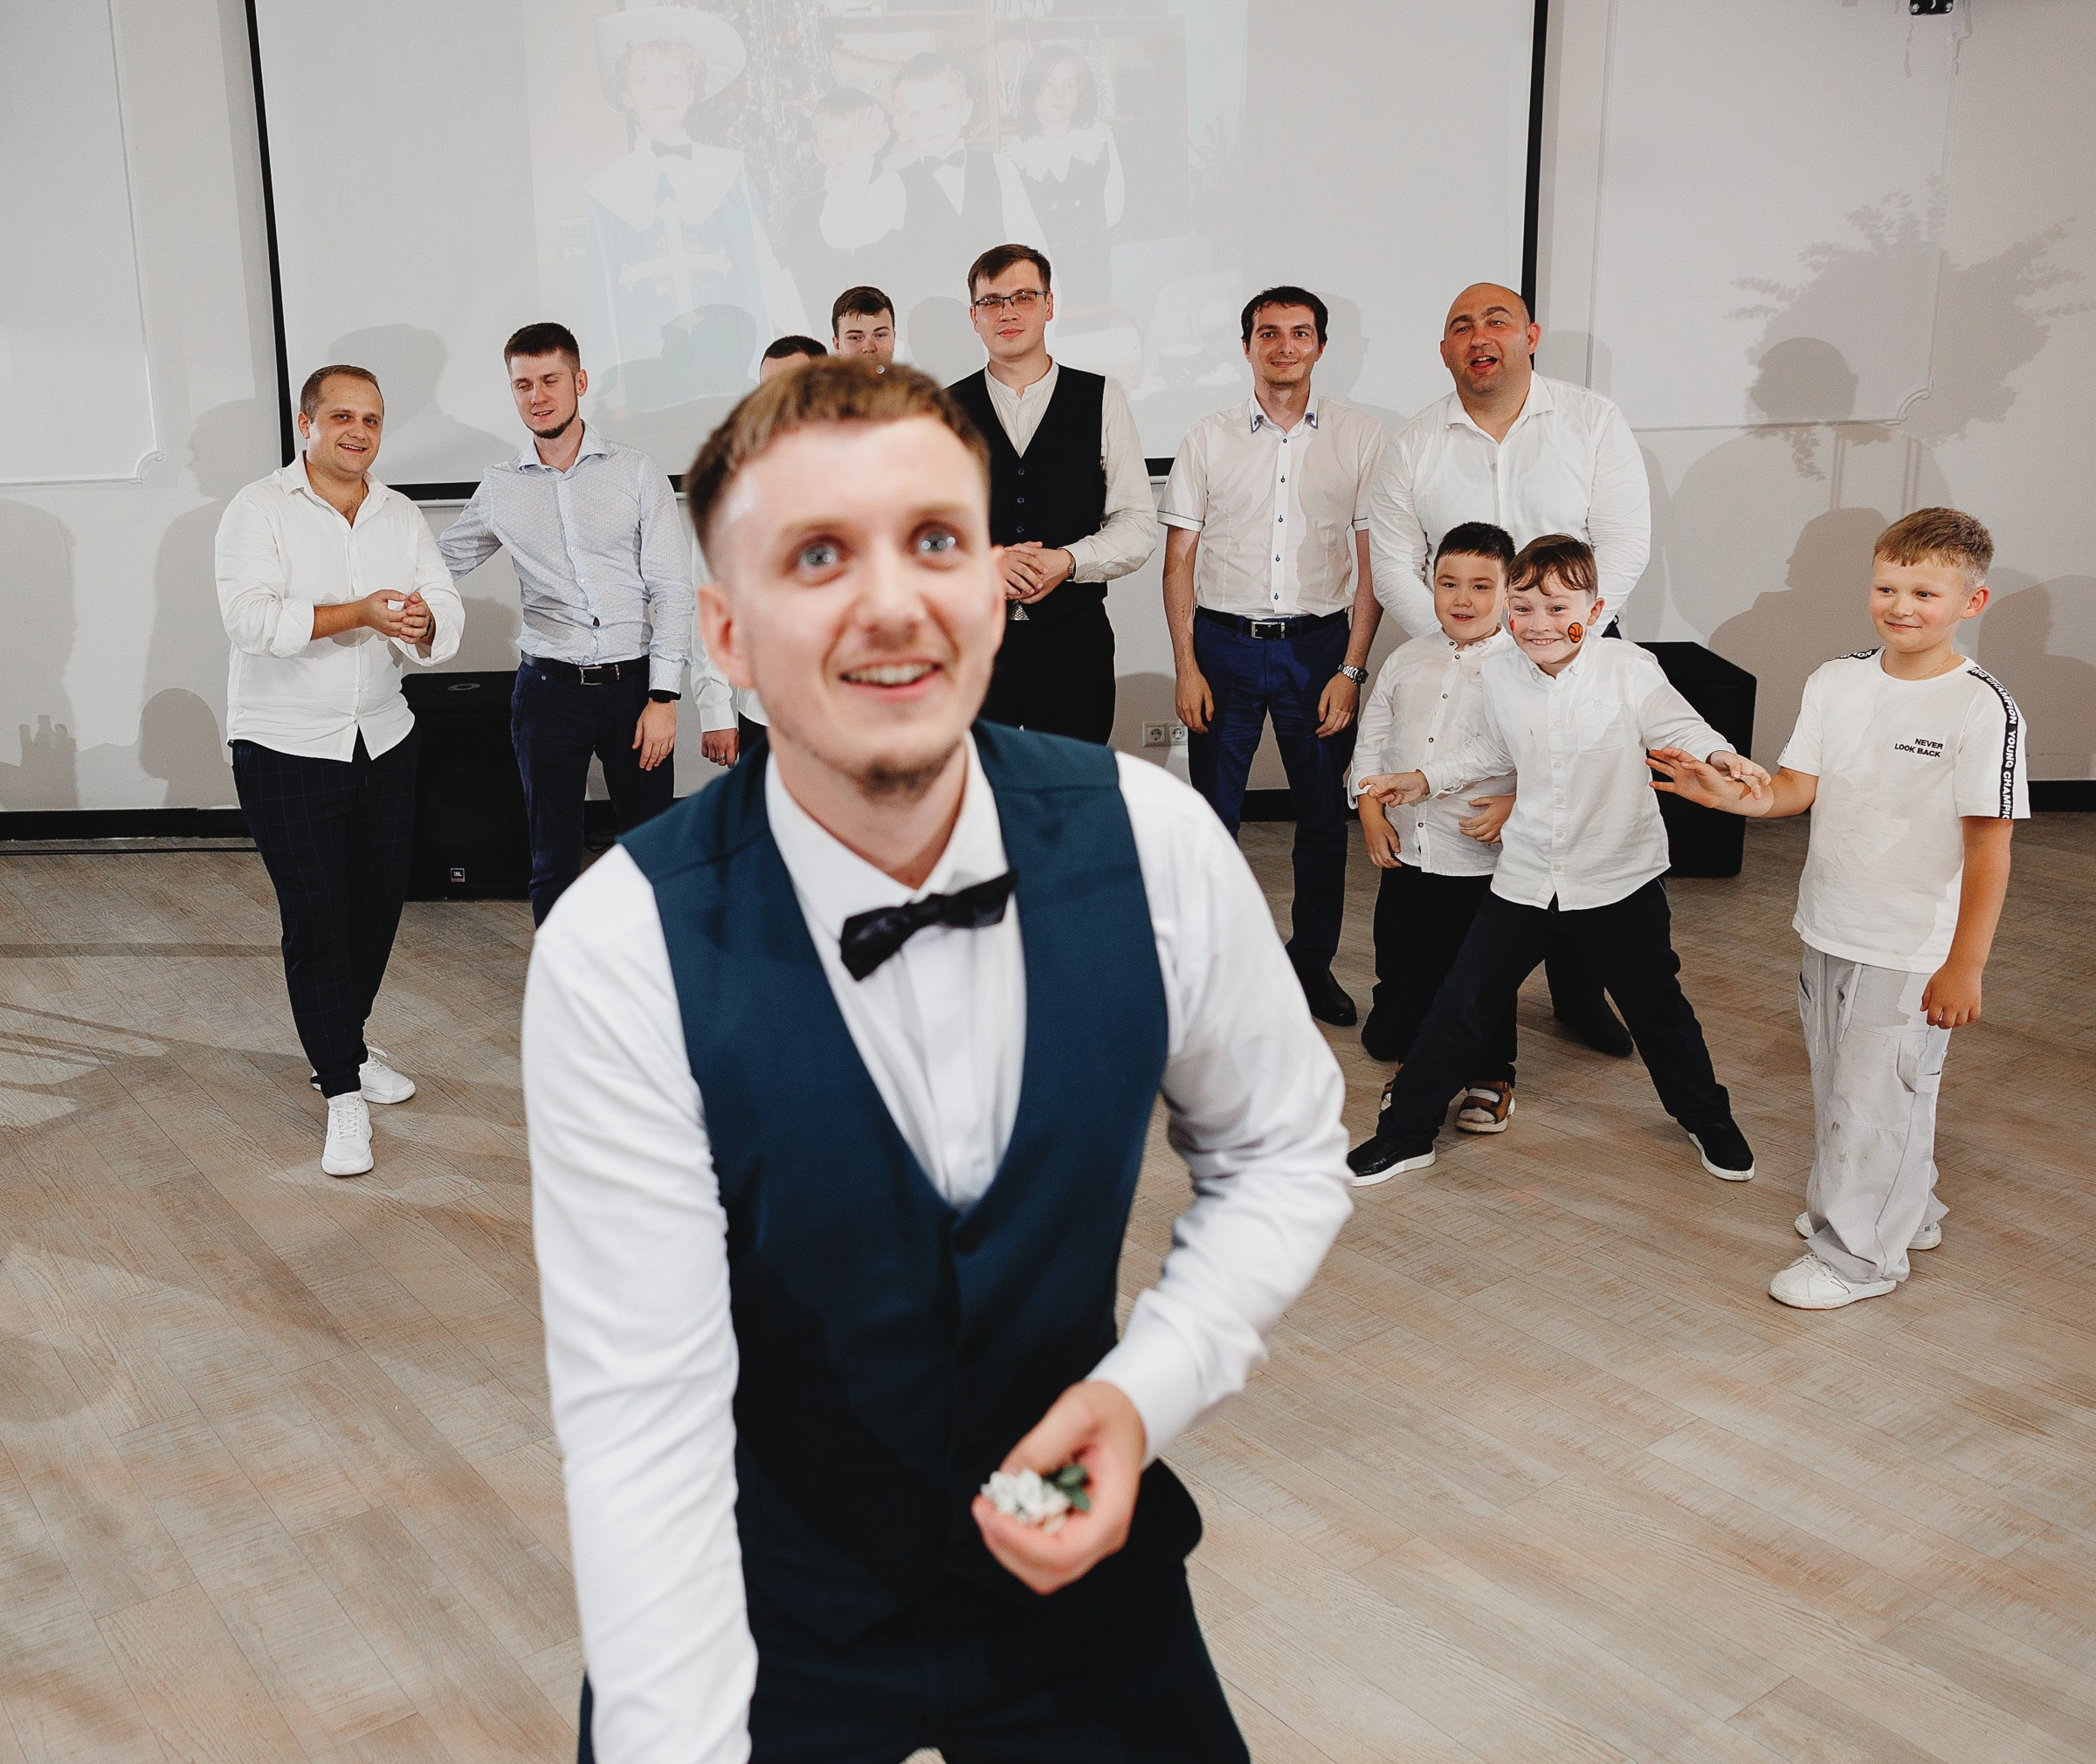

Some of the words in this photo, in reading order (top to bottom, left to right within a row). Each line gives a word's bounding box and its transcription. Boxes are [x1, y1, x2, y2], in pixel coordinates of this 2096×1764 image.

[1986, 677, 2017, 725] CHAMPION
[2004, 730, 2017, 768] YOUNG
[1894, 743, 1916, 754] LOOK
[1916, 748, 1941, 758] BACK
[1914, 738, 1944, 750] NEVER
